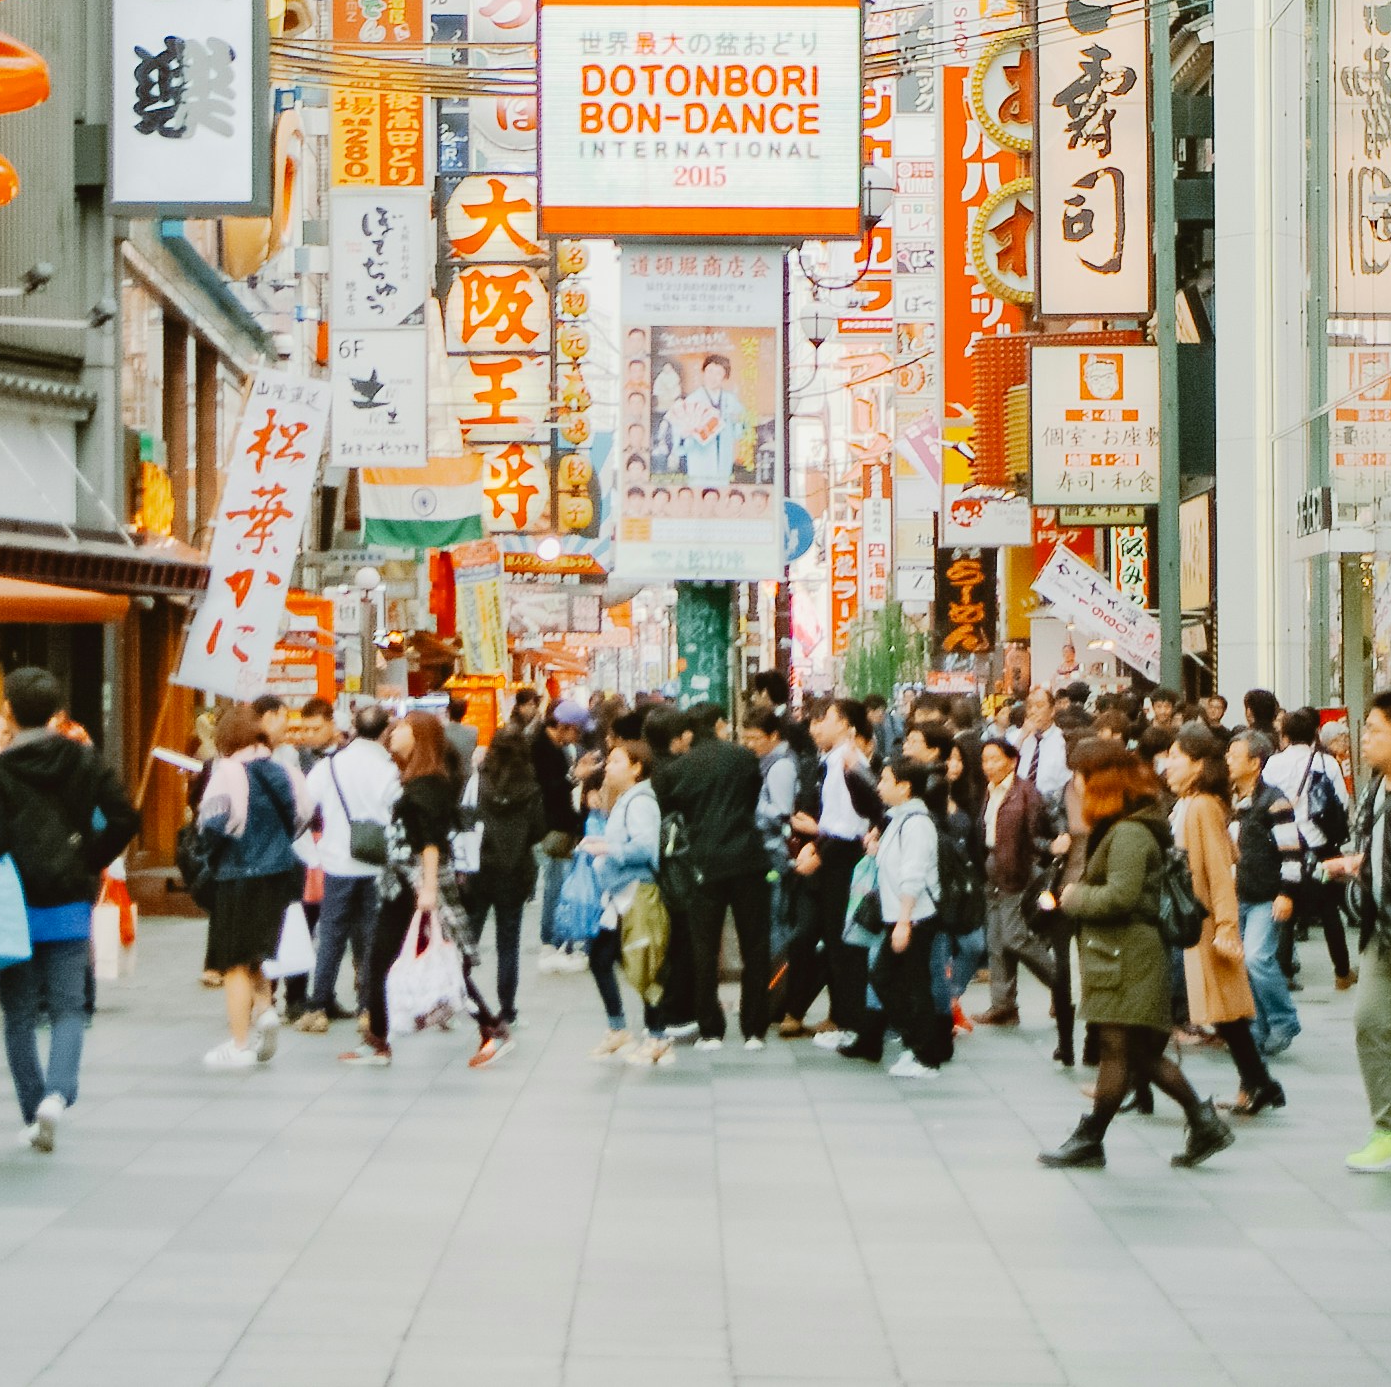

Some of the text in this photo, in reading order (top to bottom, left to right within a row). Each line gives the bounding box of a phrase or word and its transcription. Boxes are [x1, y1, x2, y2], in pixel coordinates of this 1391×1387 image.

[579, 32, 819, 57] 世界最大の盆おどり
[952, 9, 968, 60] SHOP
[580, 64, 820, 97] DOTONBORI
[578, 102, 821, 135] BON-DANCE
[343, 127, 369, 178] 280
[578, 140, 821, 160] INTERNATIONAL
[673, 164, 727, 187] 2015
[897, 177, 934, 195] YUME
[629, 253, 771, 279] 道頓堀商店会
[338, 339, 365, 359] 6F
[449, 177, 541, 529] 大阪王将
[564, 246, 587, 522] 名物元焼餃子
[1041, 425, 1160, 448] 個室・お座敷
[1055, 470, 1156, 493] 寿司・和食
[205, 407, 310, 663] 松葉かに
[943, 557, 991, 653] らーめん
